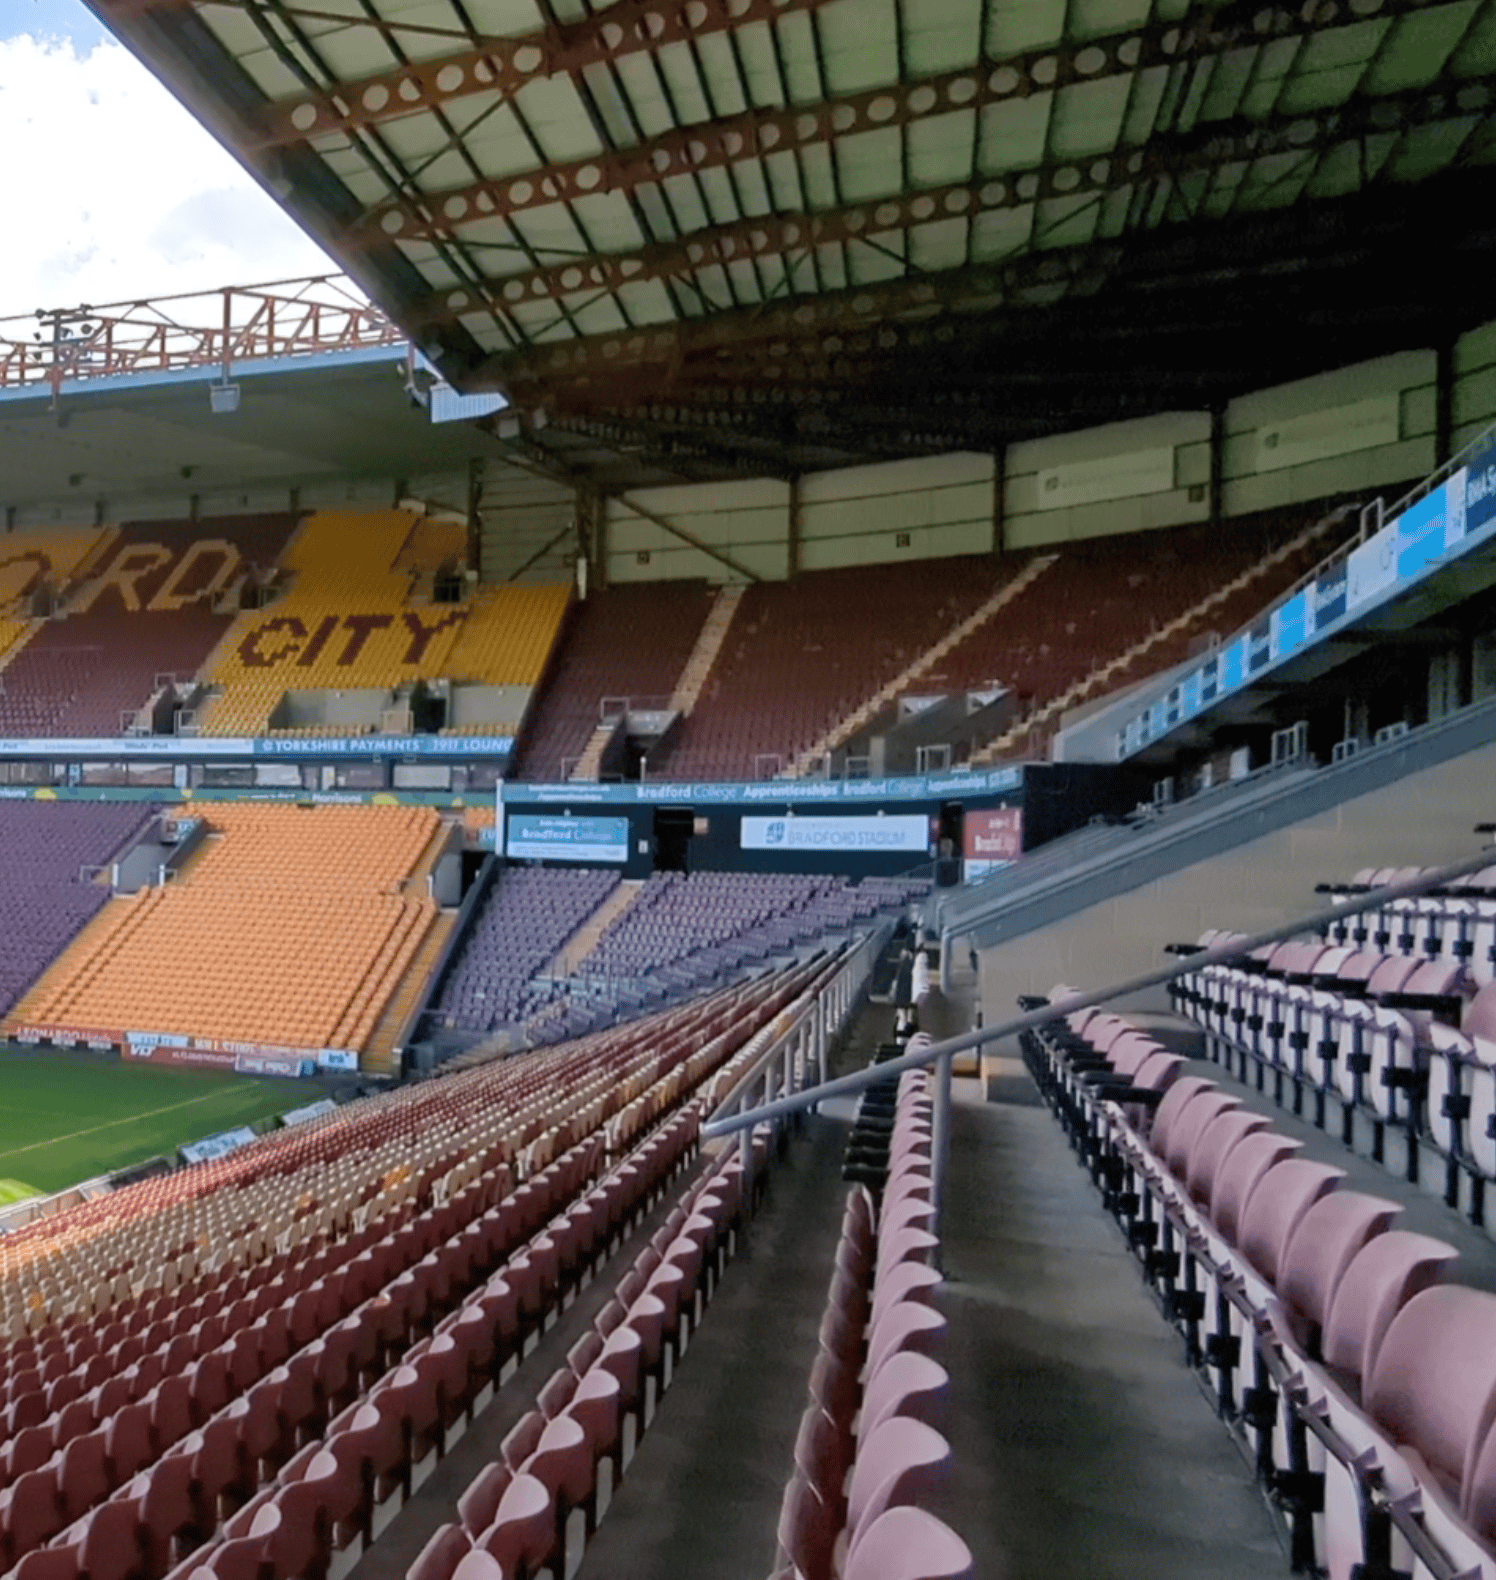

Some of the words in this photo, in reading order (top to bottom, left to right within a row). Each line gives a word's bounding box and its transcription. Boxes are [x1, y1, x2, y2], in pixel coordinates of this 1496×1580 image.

[236, 608, 470, 668] CITY
[274, 739, 347, 752] YORKSHIRE
[350, 739, 419, 752] PAYMENTS
[636, 785, 691, 798] Bradford
[743, 783, 838, 799] Apprenticeships
[788, 830, 857, 845] BRADFORD
